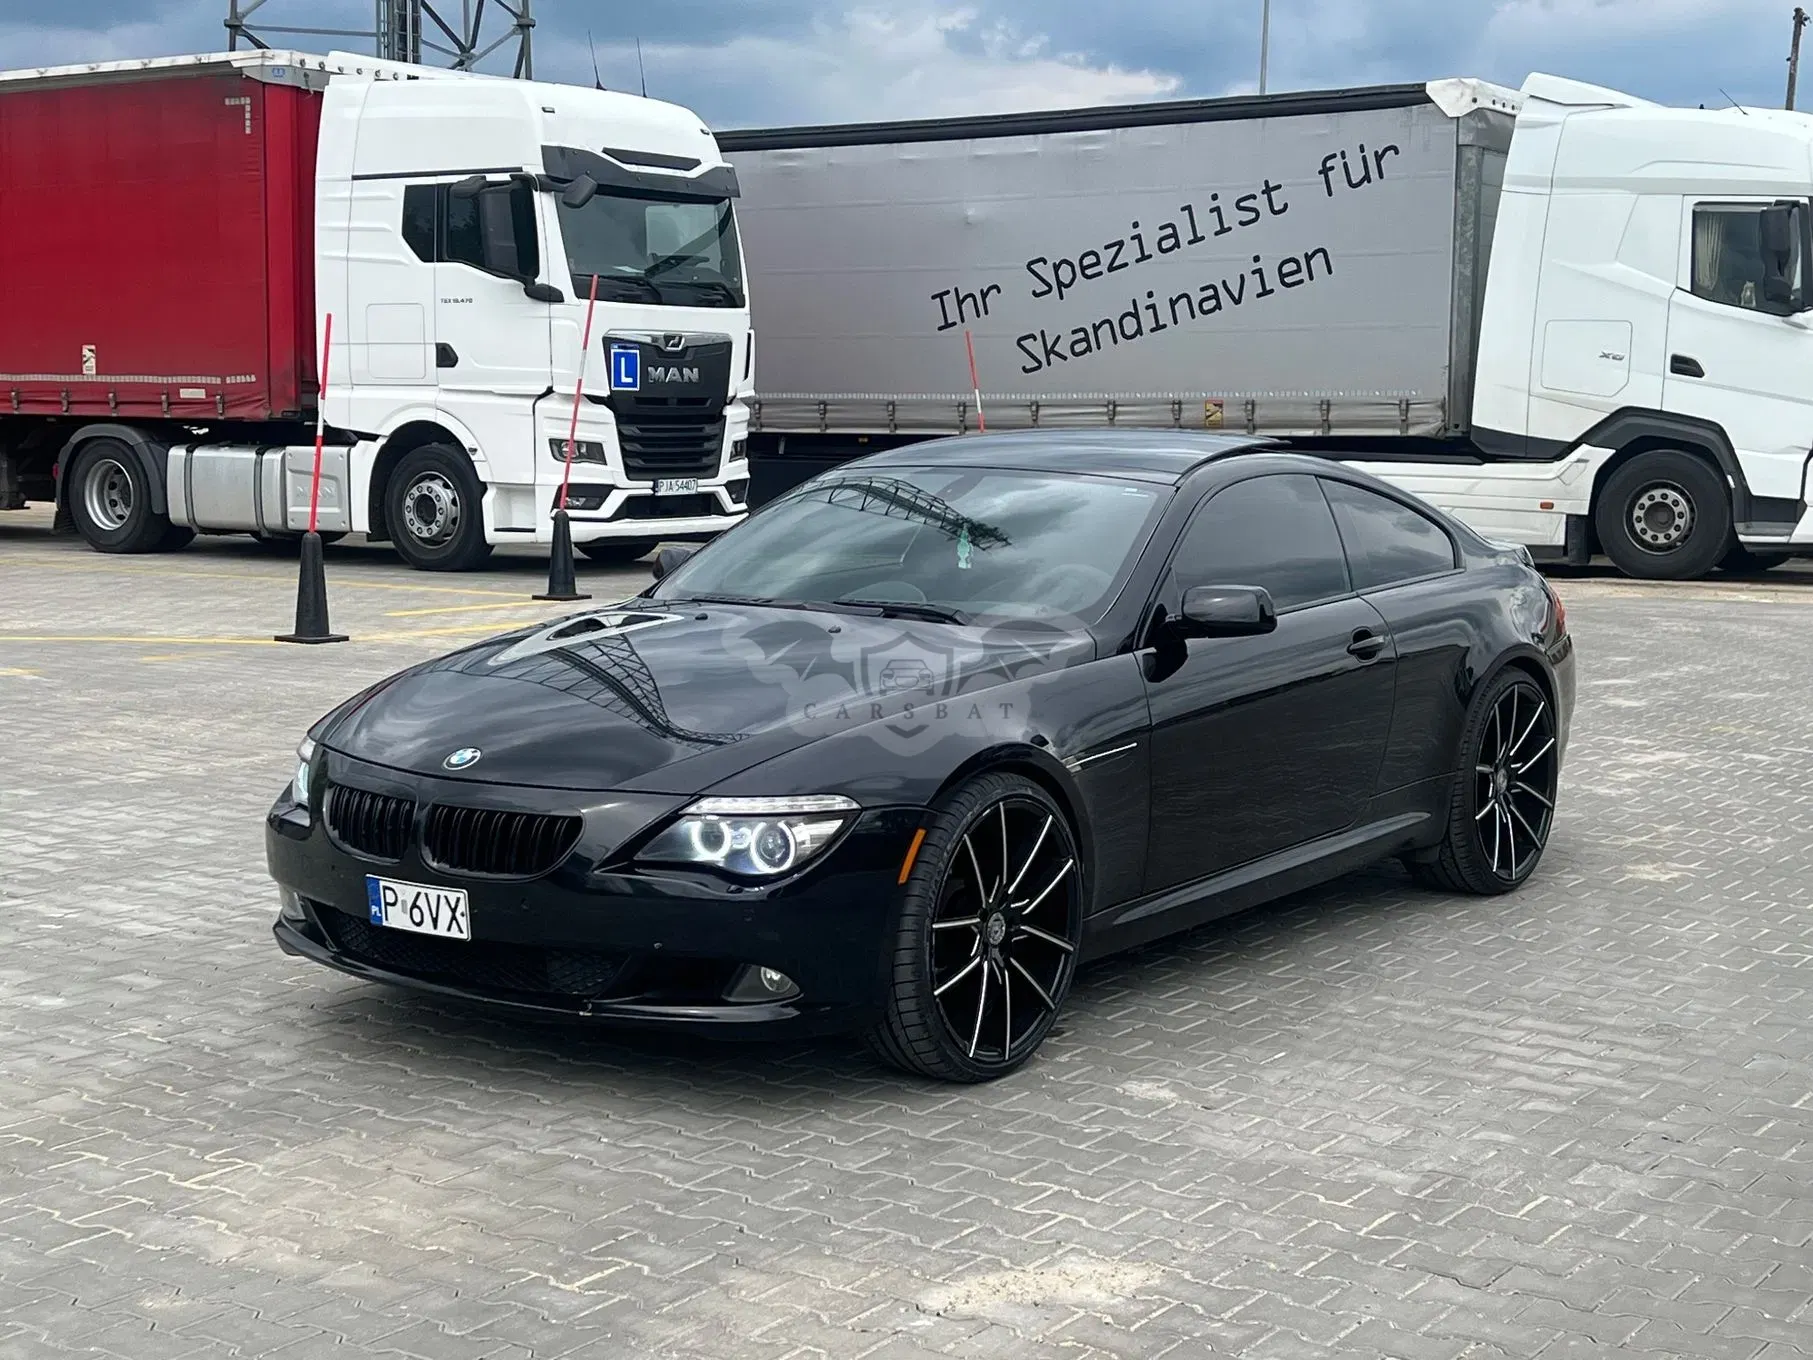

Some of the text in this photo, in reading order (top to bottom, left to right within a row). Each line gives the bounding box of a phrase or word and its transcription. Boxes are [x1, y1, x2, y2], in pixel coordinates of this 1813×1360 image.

[931, 143, 1400, 331] Ihr Spezialist für
[1017, 247, 1333, 374] Skandinavien
[621, 356, 633, 383] L
[647, 366, 699, 383] MAN
